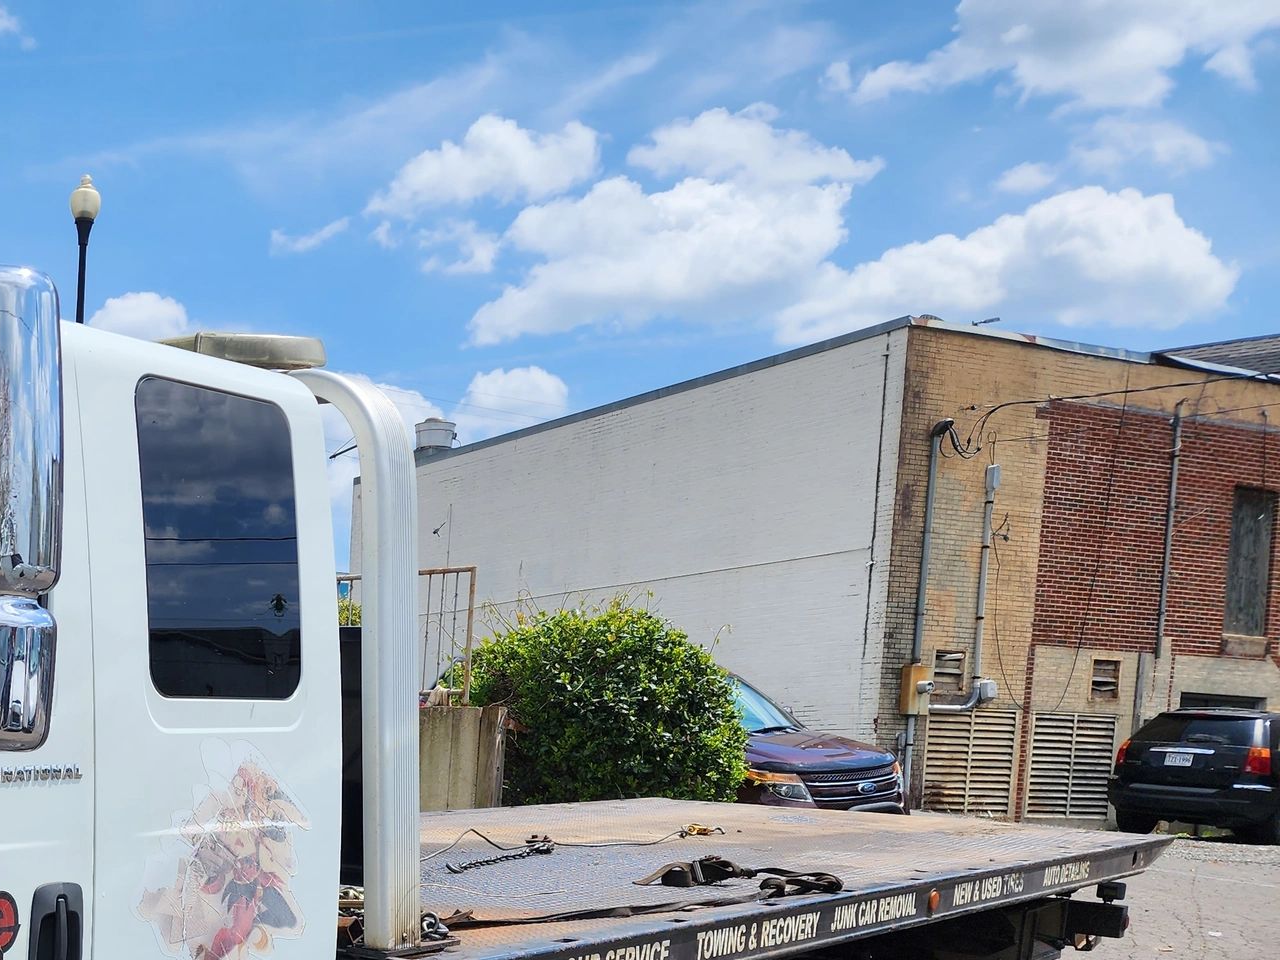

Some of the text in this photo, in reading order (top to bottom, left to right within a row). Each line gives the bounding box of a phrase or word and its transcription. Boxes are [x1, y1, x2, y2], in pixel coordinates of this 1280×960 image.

[952, 881, 974, 906] NEW
[973, 880, 980, 901] &
[981, 876, 1003, 900] USED
[1043, 865, 1061, 887] AUTO
[831, 892, 918, 932] JUNK CAR REMOVAL
[696, 911, 821, 960] TOWING & RECOVERY
